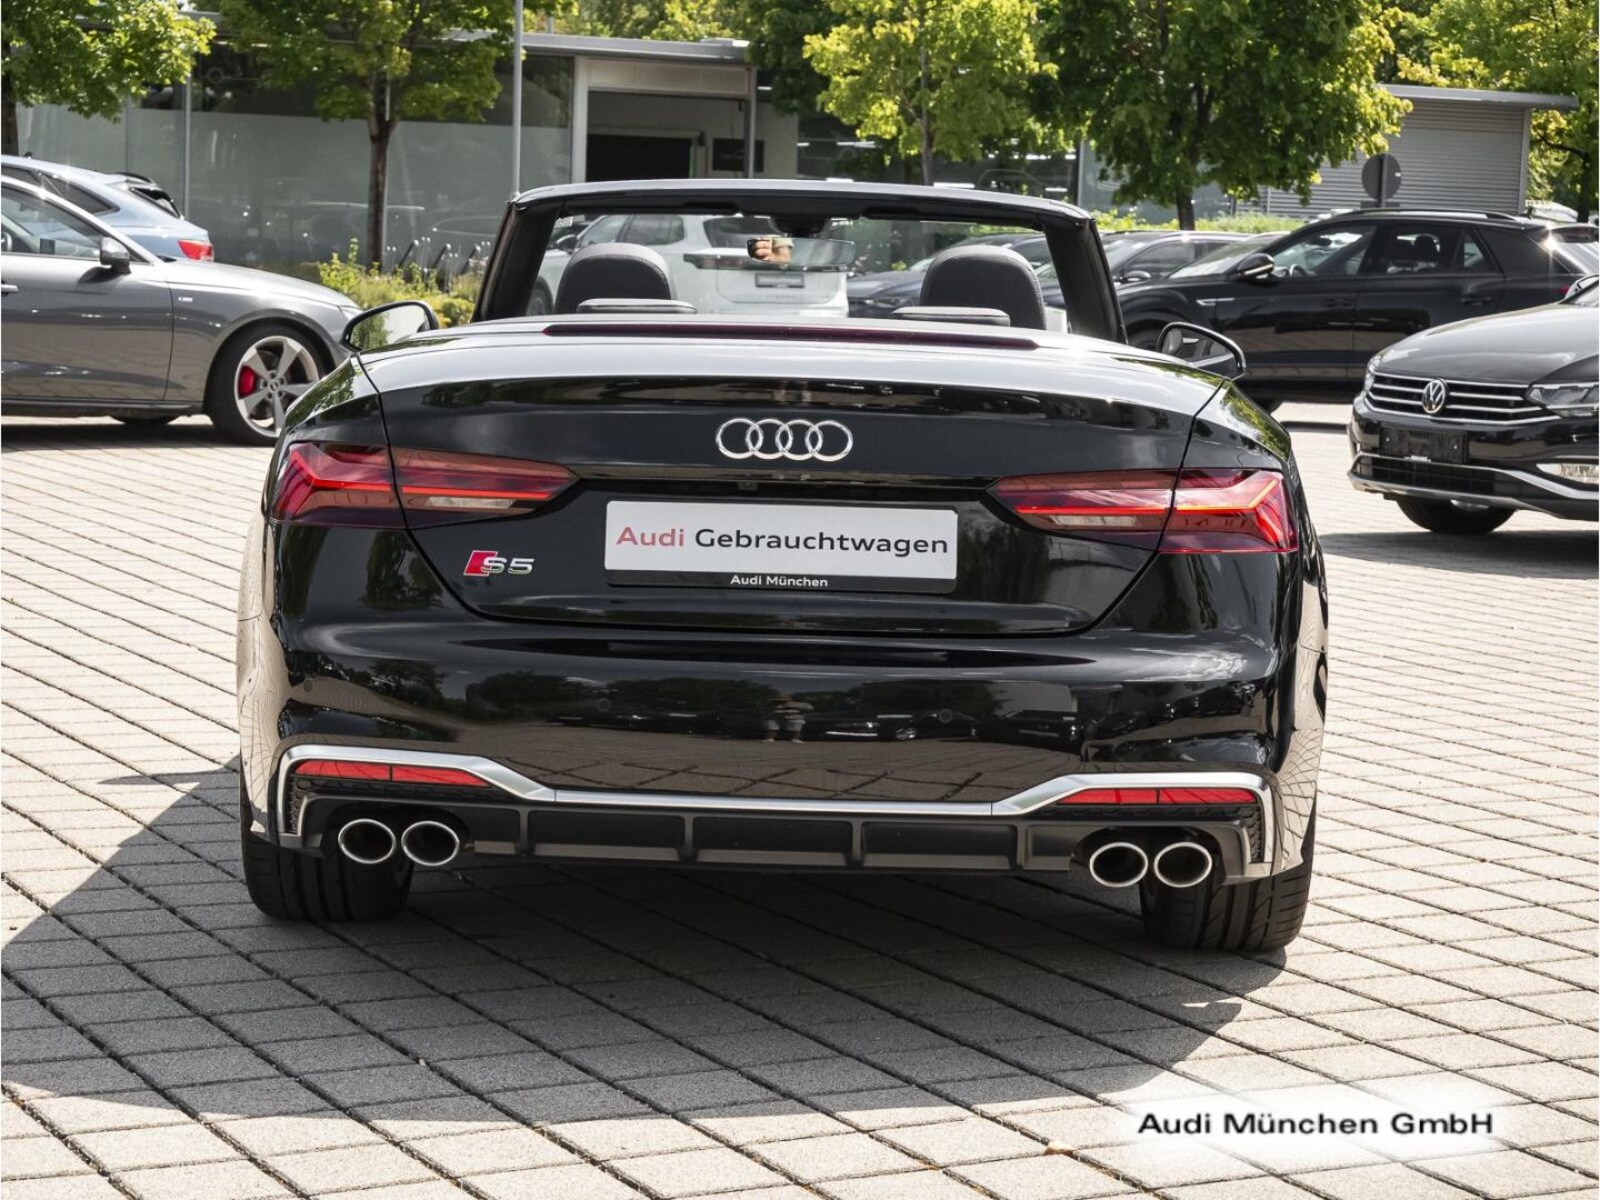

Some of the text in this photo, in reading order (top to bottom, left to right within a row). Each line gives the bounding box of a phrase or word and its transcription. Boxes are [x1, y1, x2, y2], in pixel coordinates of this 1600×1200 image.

[615, 526, 949, 558] Audi Gebrauchtwagen
[480, 556, 535, 575] S5
[729, 574, 829, 588] Audi München
